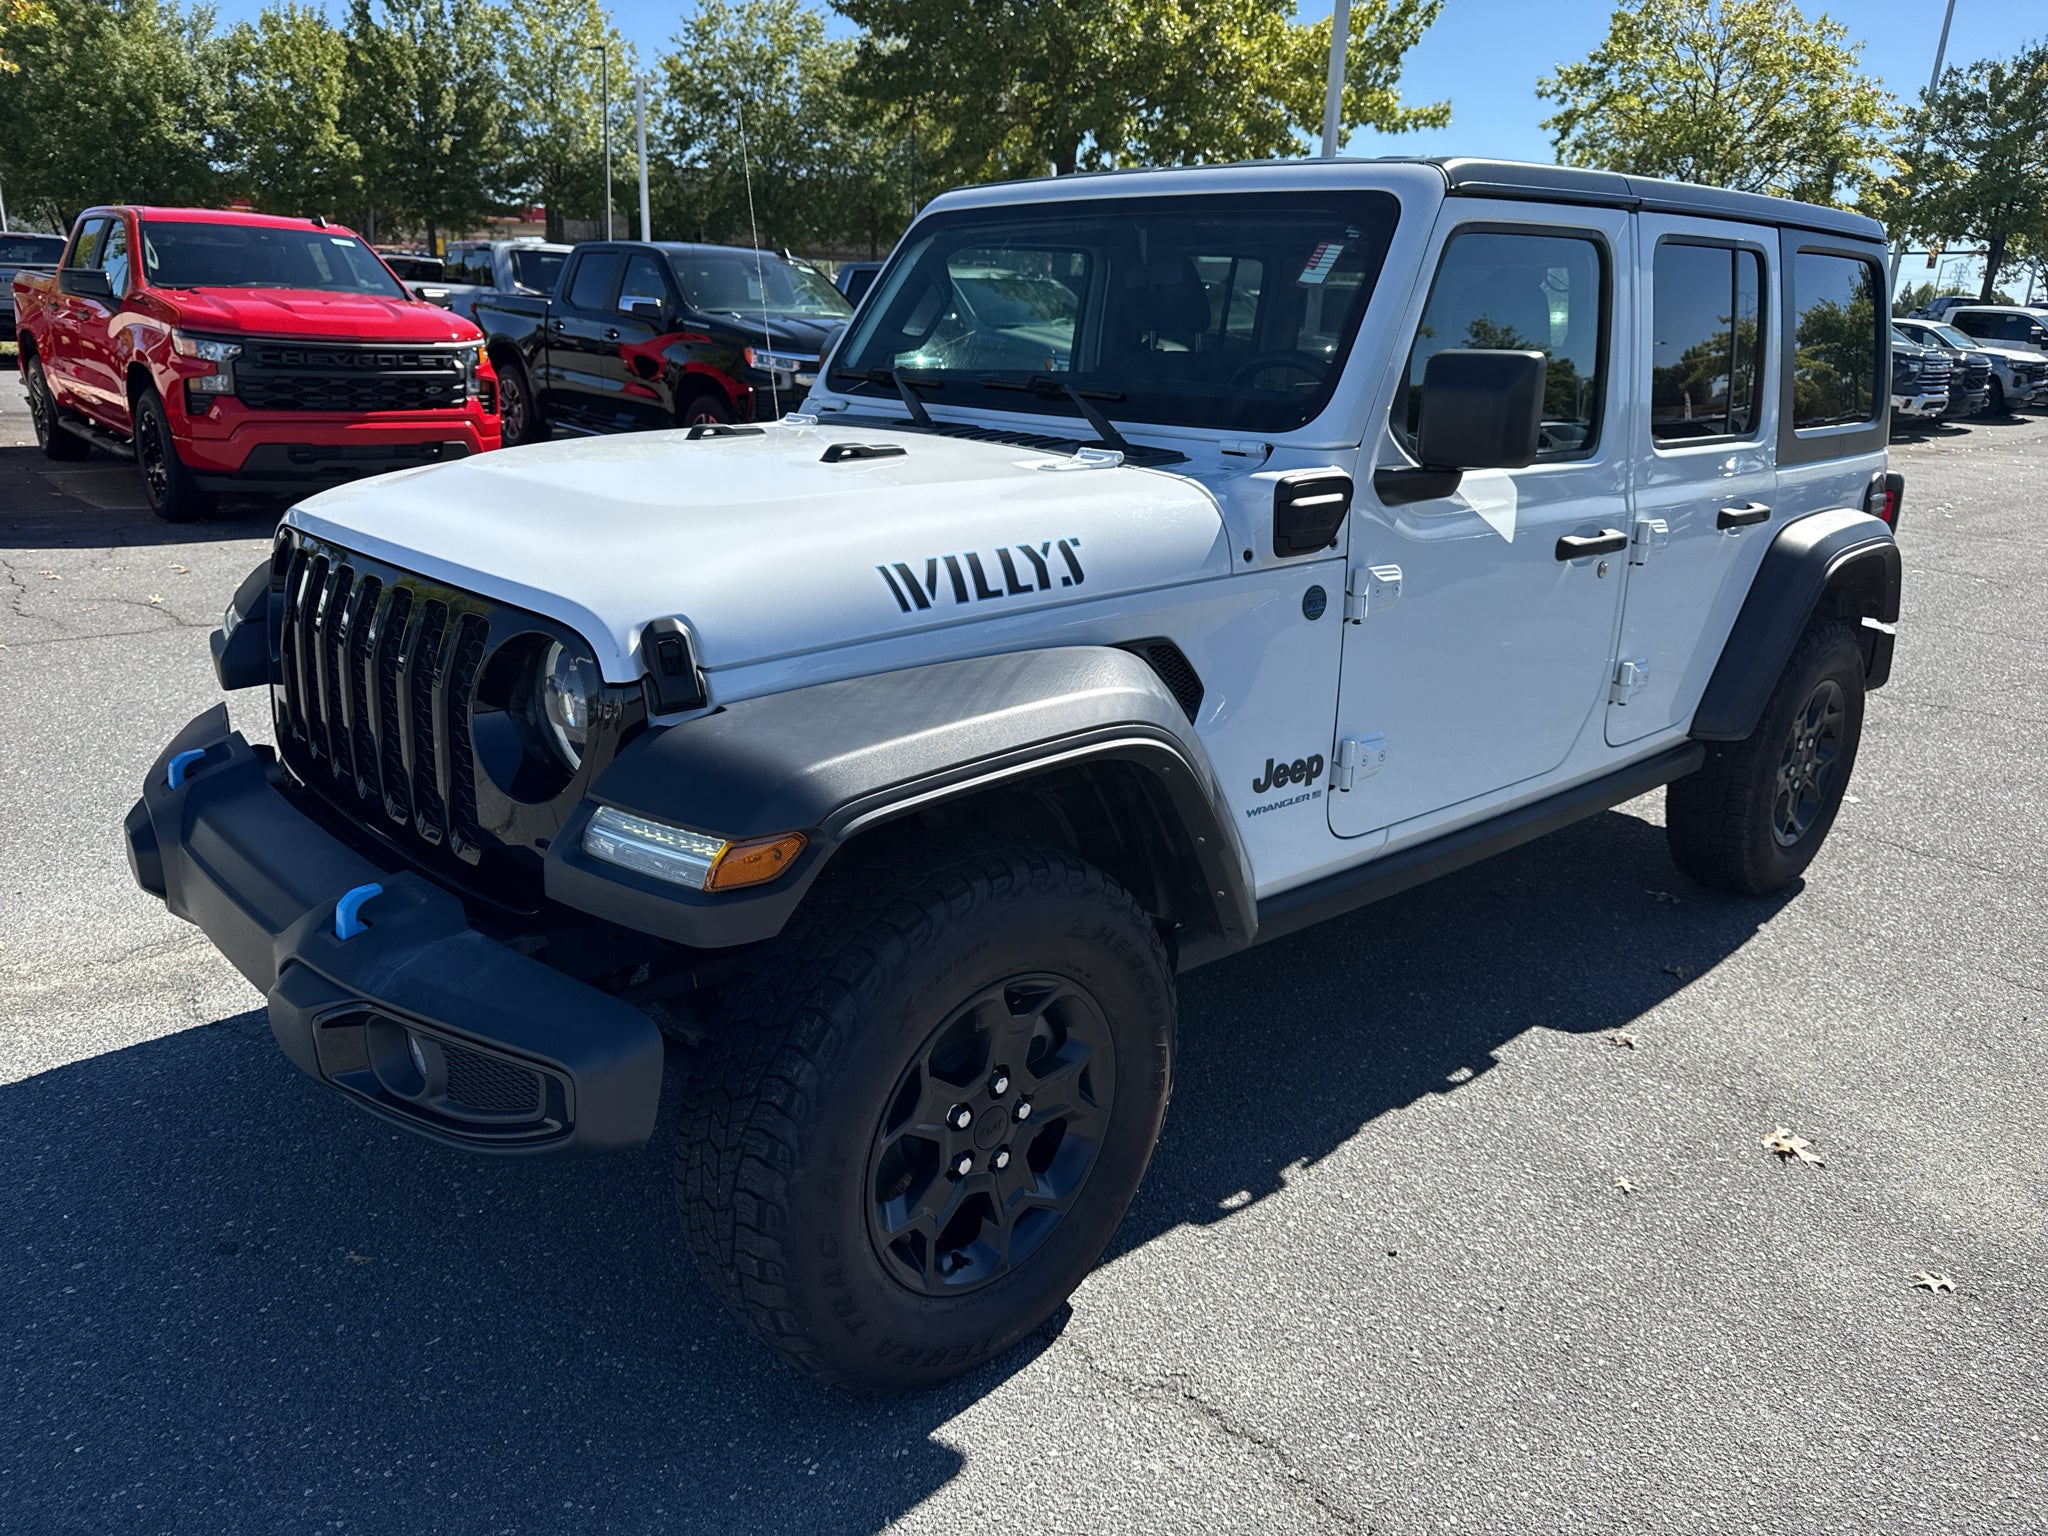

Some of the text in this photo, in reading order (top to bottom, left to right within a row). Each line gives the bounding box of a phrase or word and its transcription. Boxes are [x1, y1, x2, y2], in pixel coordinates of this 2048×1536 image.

[253, 350, 453, 368] CHEVROLET
[875, 537, 1085, 613] WILLYS
[1252, 753, 1324, 794] Jeep
[1245, 793, 1311, 818] WRANGLER
[1090, 922, 1167, 1098] HERCULES
[818, 1231, 871, 1337] TRAC
[871, 1336, 992, 1368] TERRA
